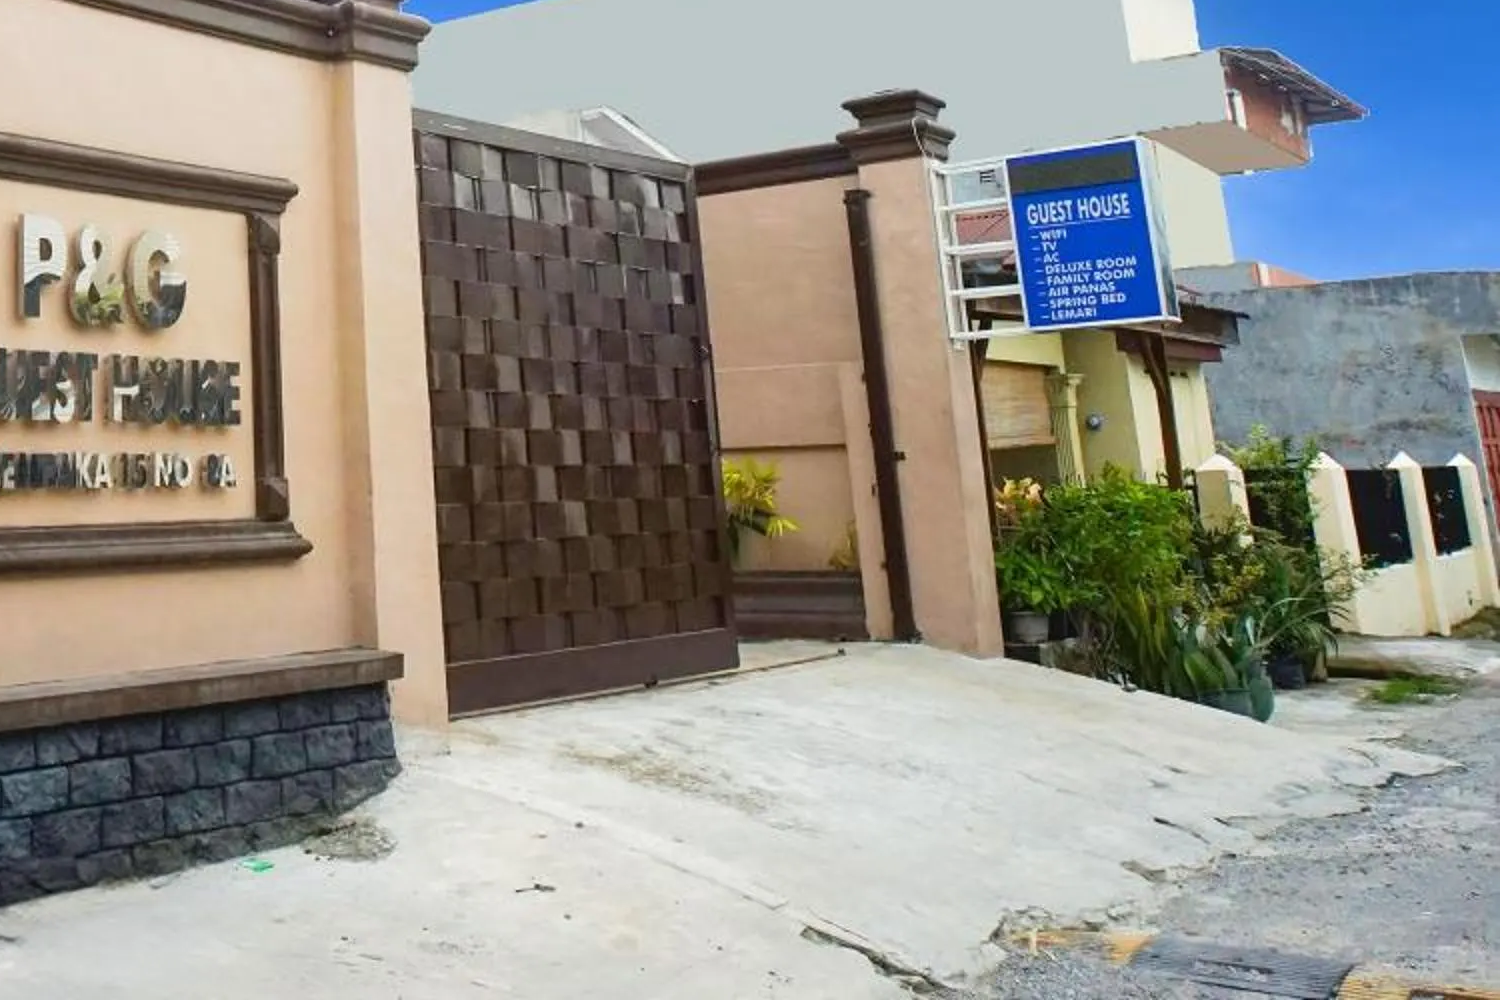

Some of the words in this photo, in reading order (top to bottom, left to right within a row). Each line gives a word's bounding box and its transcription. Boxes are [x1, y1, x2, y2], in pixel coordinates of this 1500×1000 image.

[1027, 199, 1073, 225] GUEST
[1077, 192, 1130, 219] HOUSE
[1096, 256, 1137, 269] ROOM
[18, 213, 188, 329] P&G
[1093, 268, 1135, 281] ROOM
[1073, 282, 1116, 294] PANAS
[1101, 292, 1127, 304] BED
[107, 353, 241, 426] HOUSE
